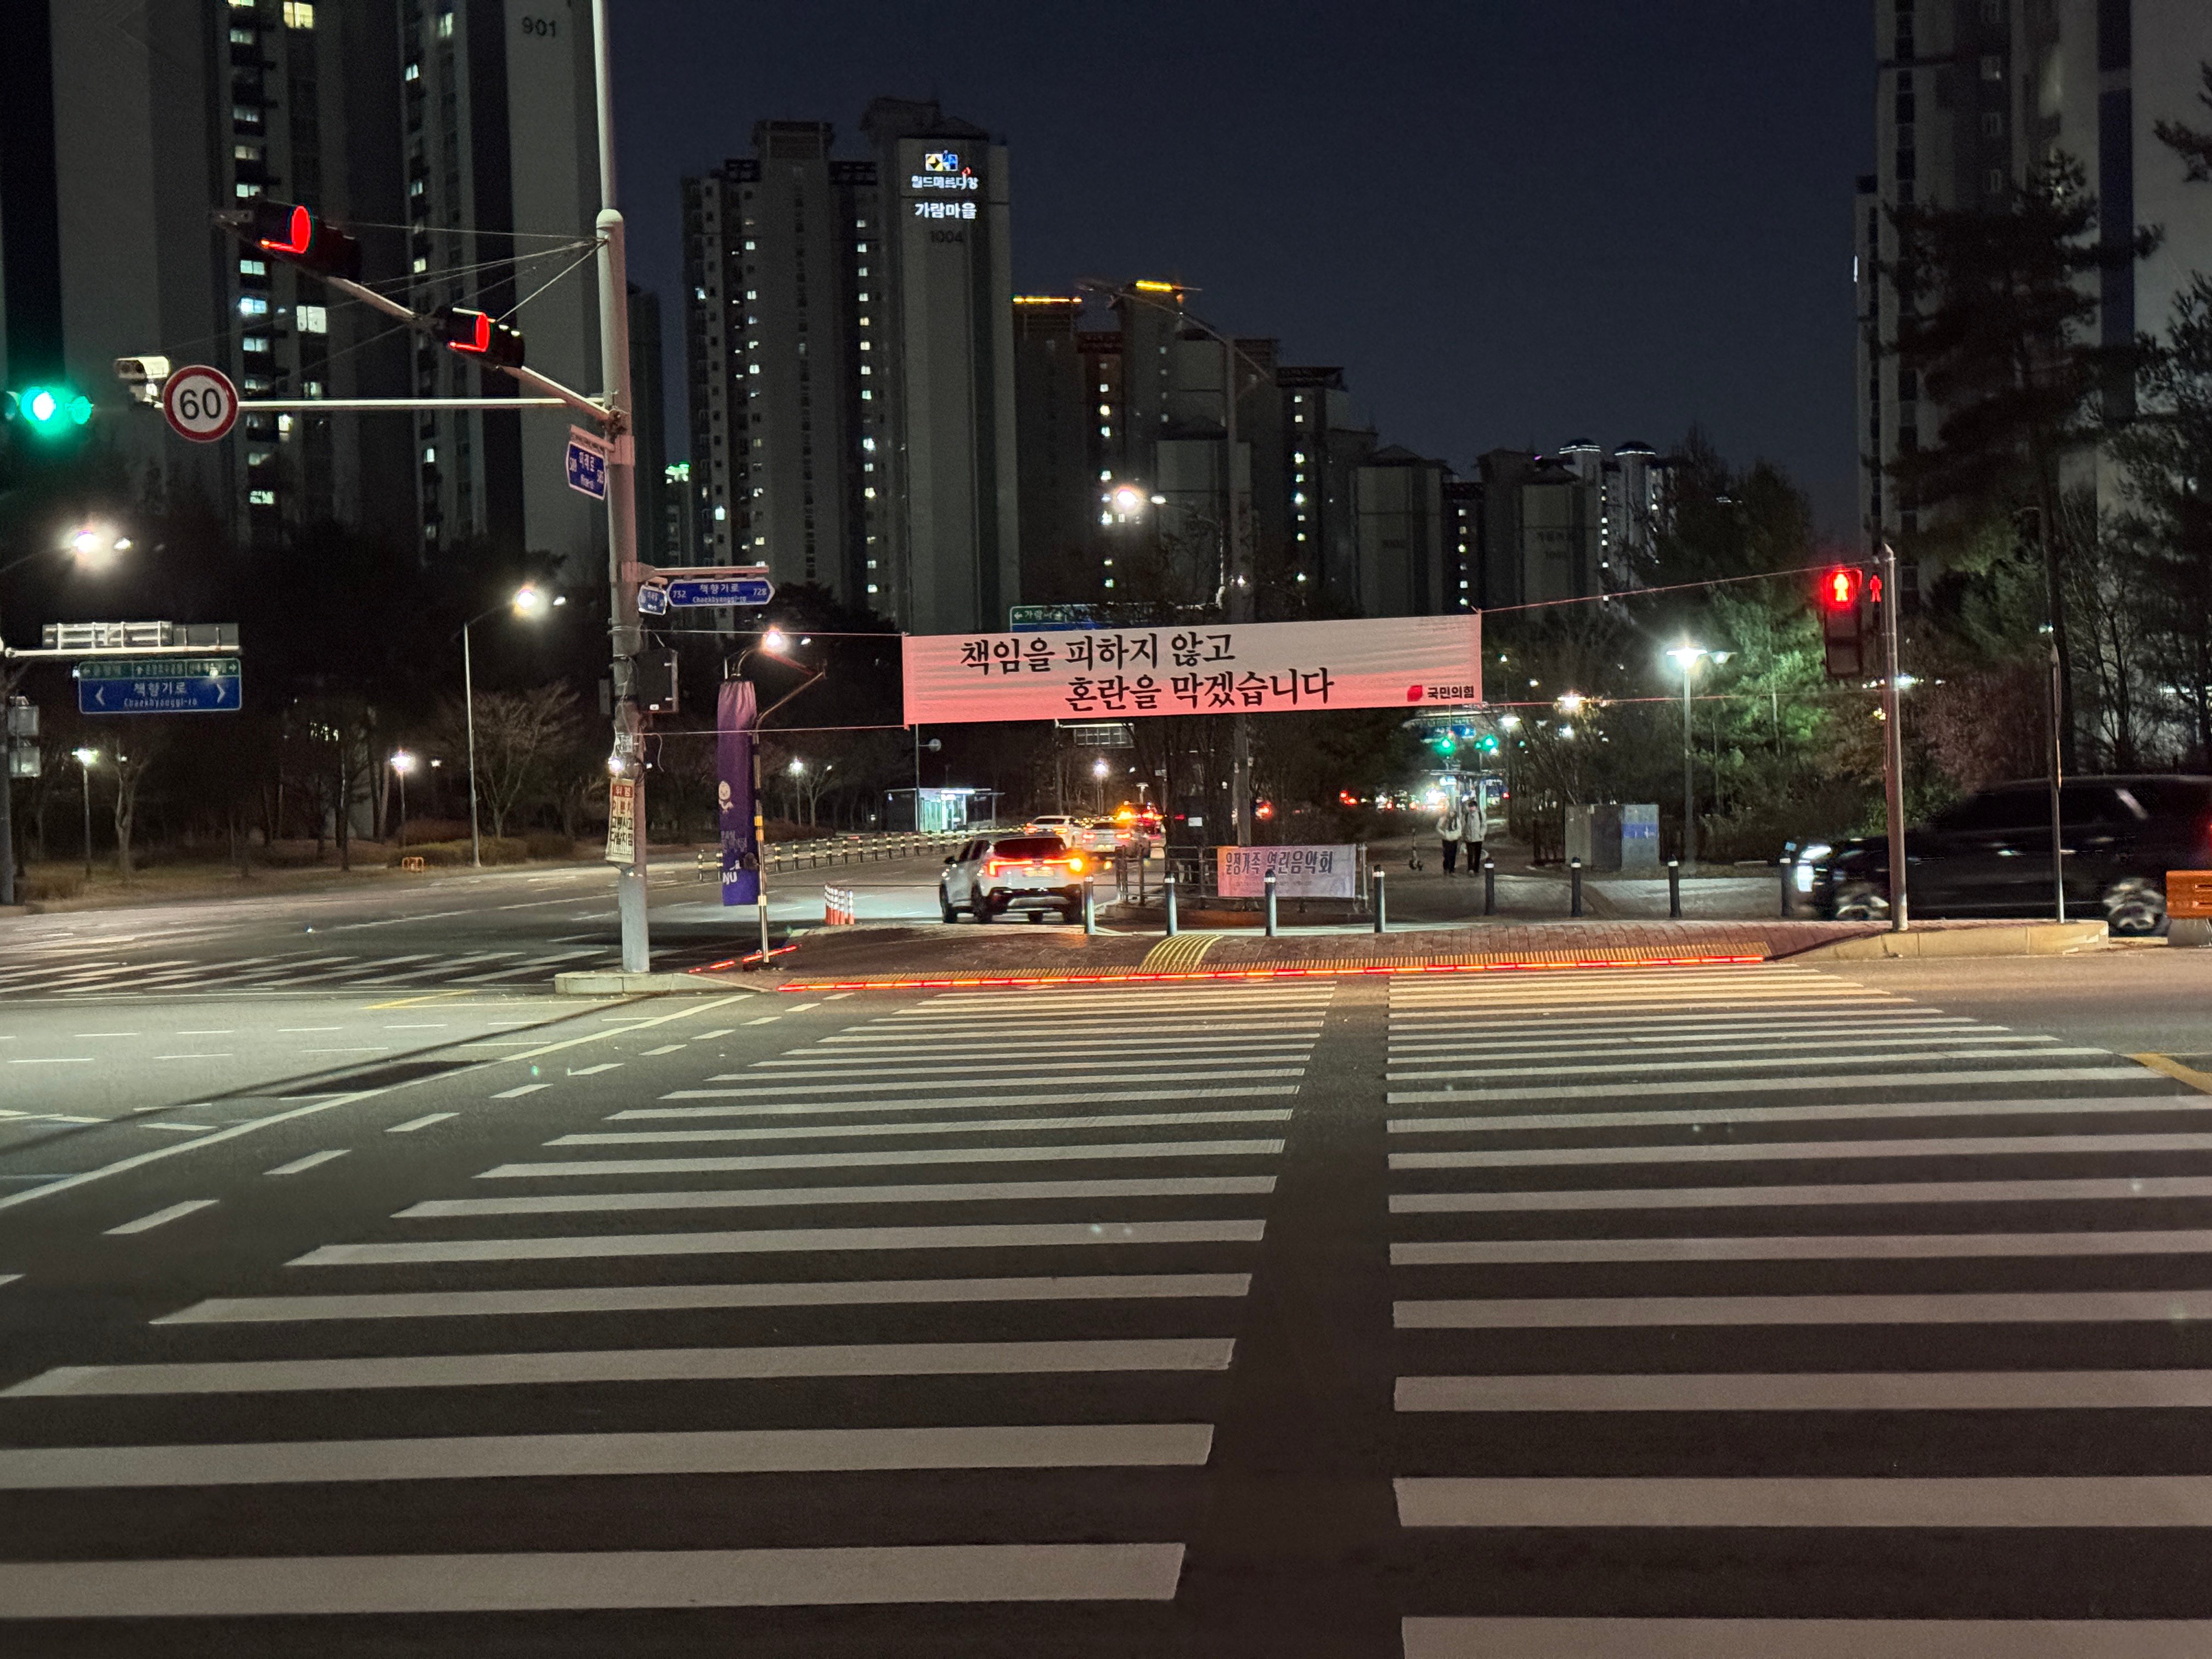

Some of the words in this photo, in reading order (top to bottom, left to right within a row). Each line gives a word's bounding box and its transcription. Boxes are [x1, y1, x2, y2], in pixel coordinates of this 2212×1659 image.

[522, 16, 556, 38] 901
[915, 201, 977, 219] 가람마을
[179, 388, 222, 420] 60
[673, 590, 687, 598] 732
[699, 583, 740, 595] 책향기로
[753, 588, 768, 596] 728
[960, 636, 1056, 675] 책임을
[1065, 632, 1158, 672] 피하지
[1171, 631, 1236, 668] 않고
[1065, 674, 1162, 712] 혼란을
[1170, 666, 1335, 710] 막겠습니다
[1427, 685, 1475, 700] 국민의힘
[615, 786, 631, 797] 위험
[1226, 851, 1261, 875] 운정가족
[1266, 850, 1334, 875] 열린음악회
